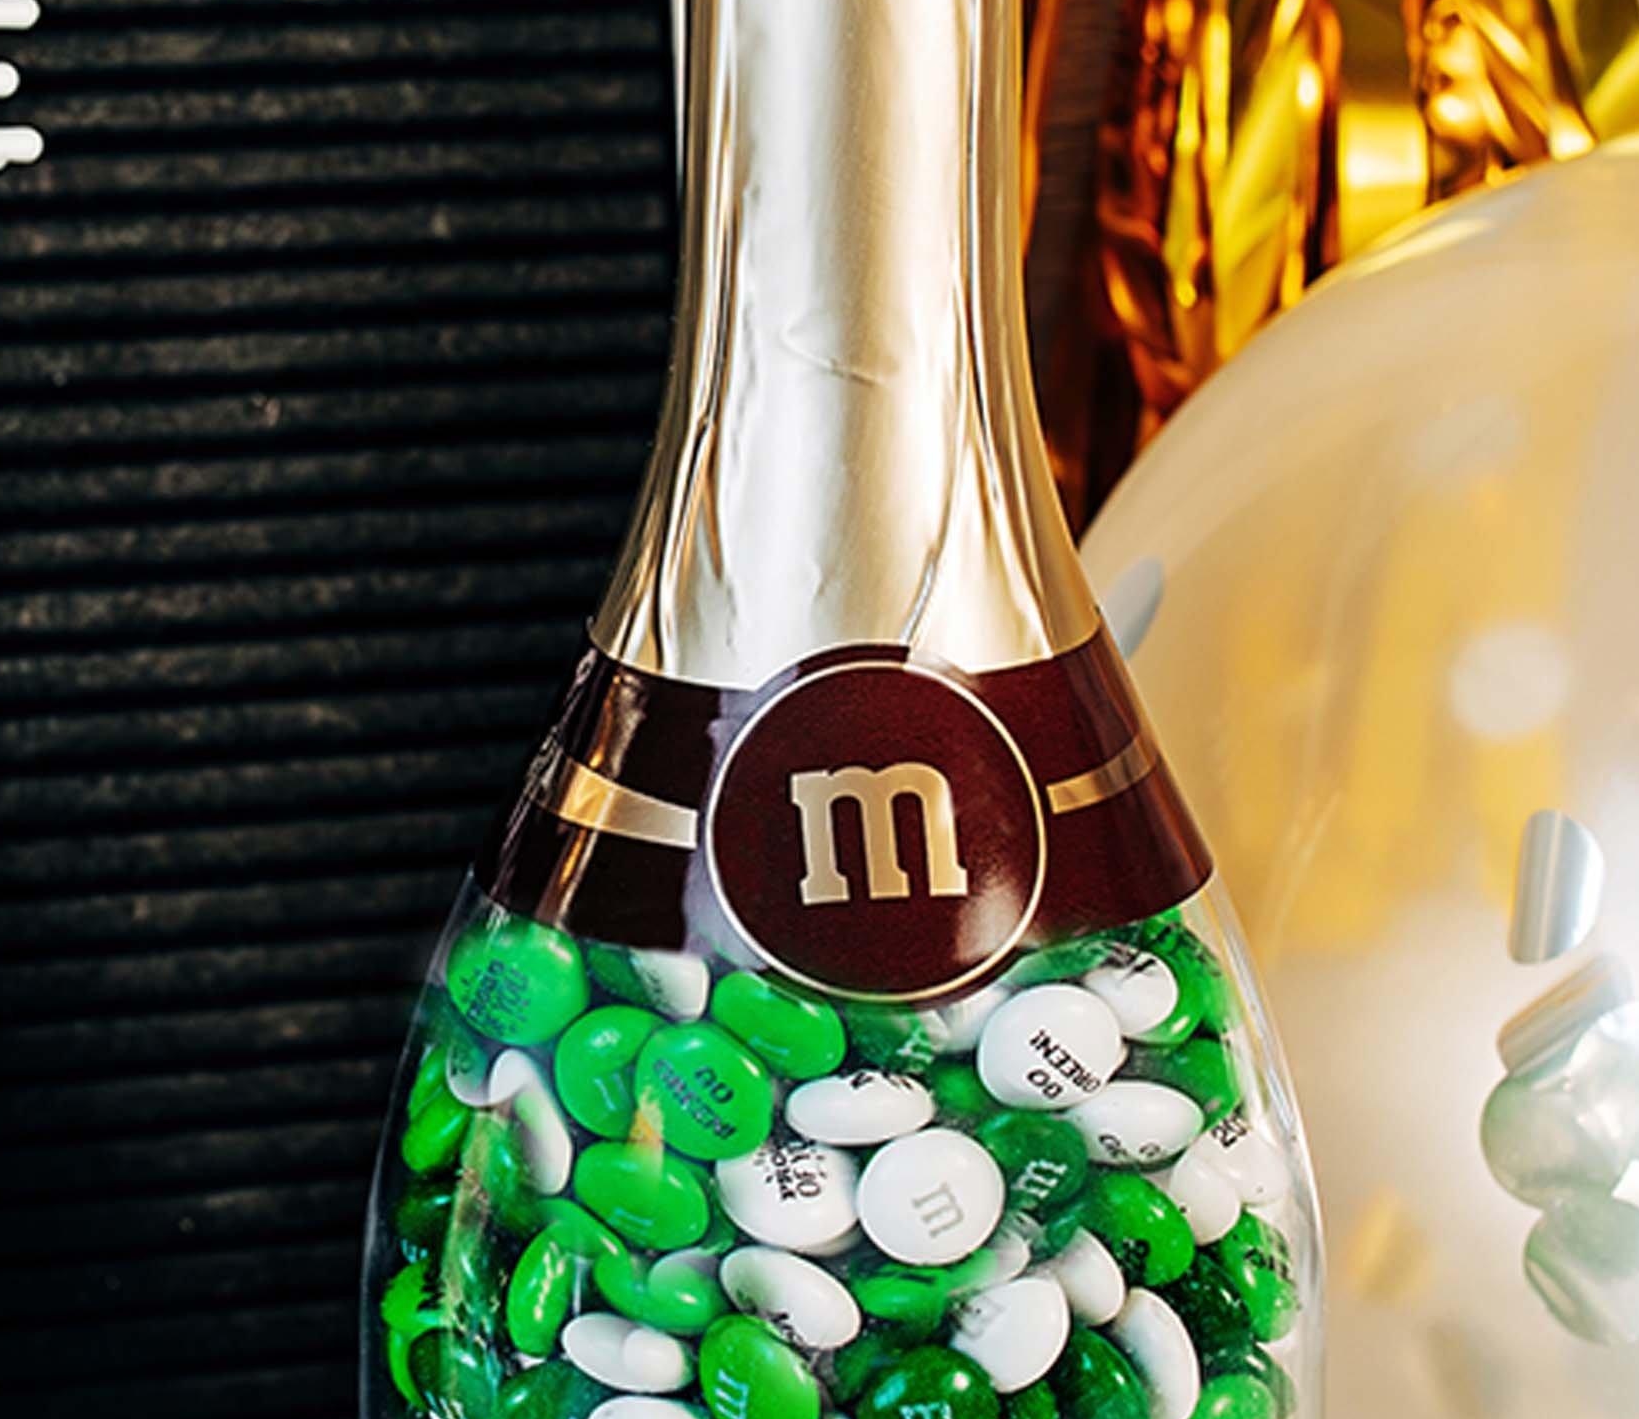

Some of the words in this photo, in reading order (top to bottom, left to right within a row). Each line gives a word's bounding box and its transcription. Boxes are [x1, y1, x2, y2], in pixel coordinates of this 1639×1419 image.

[791, 762, 967, 905] m
[694, 1065, 735, 1104] GO
[1027, 1068, 1063, 1099] GO
[1029, 1030, 1101, 1093] GREEN!
[912, 1182, 964, 1239] m
